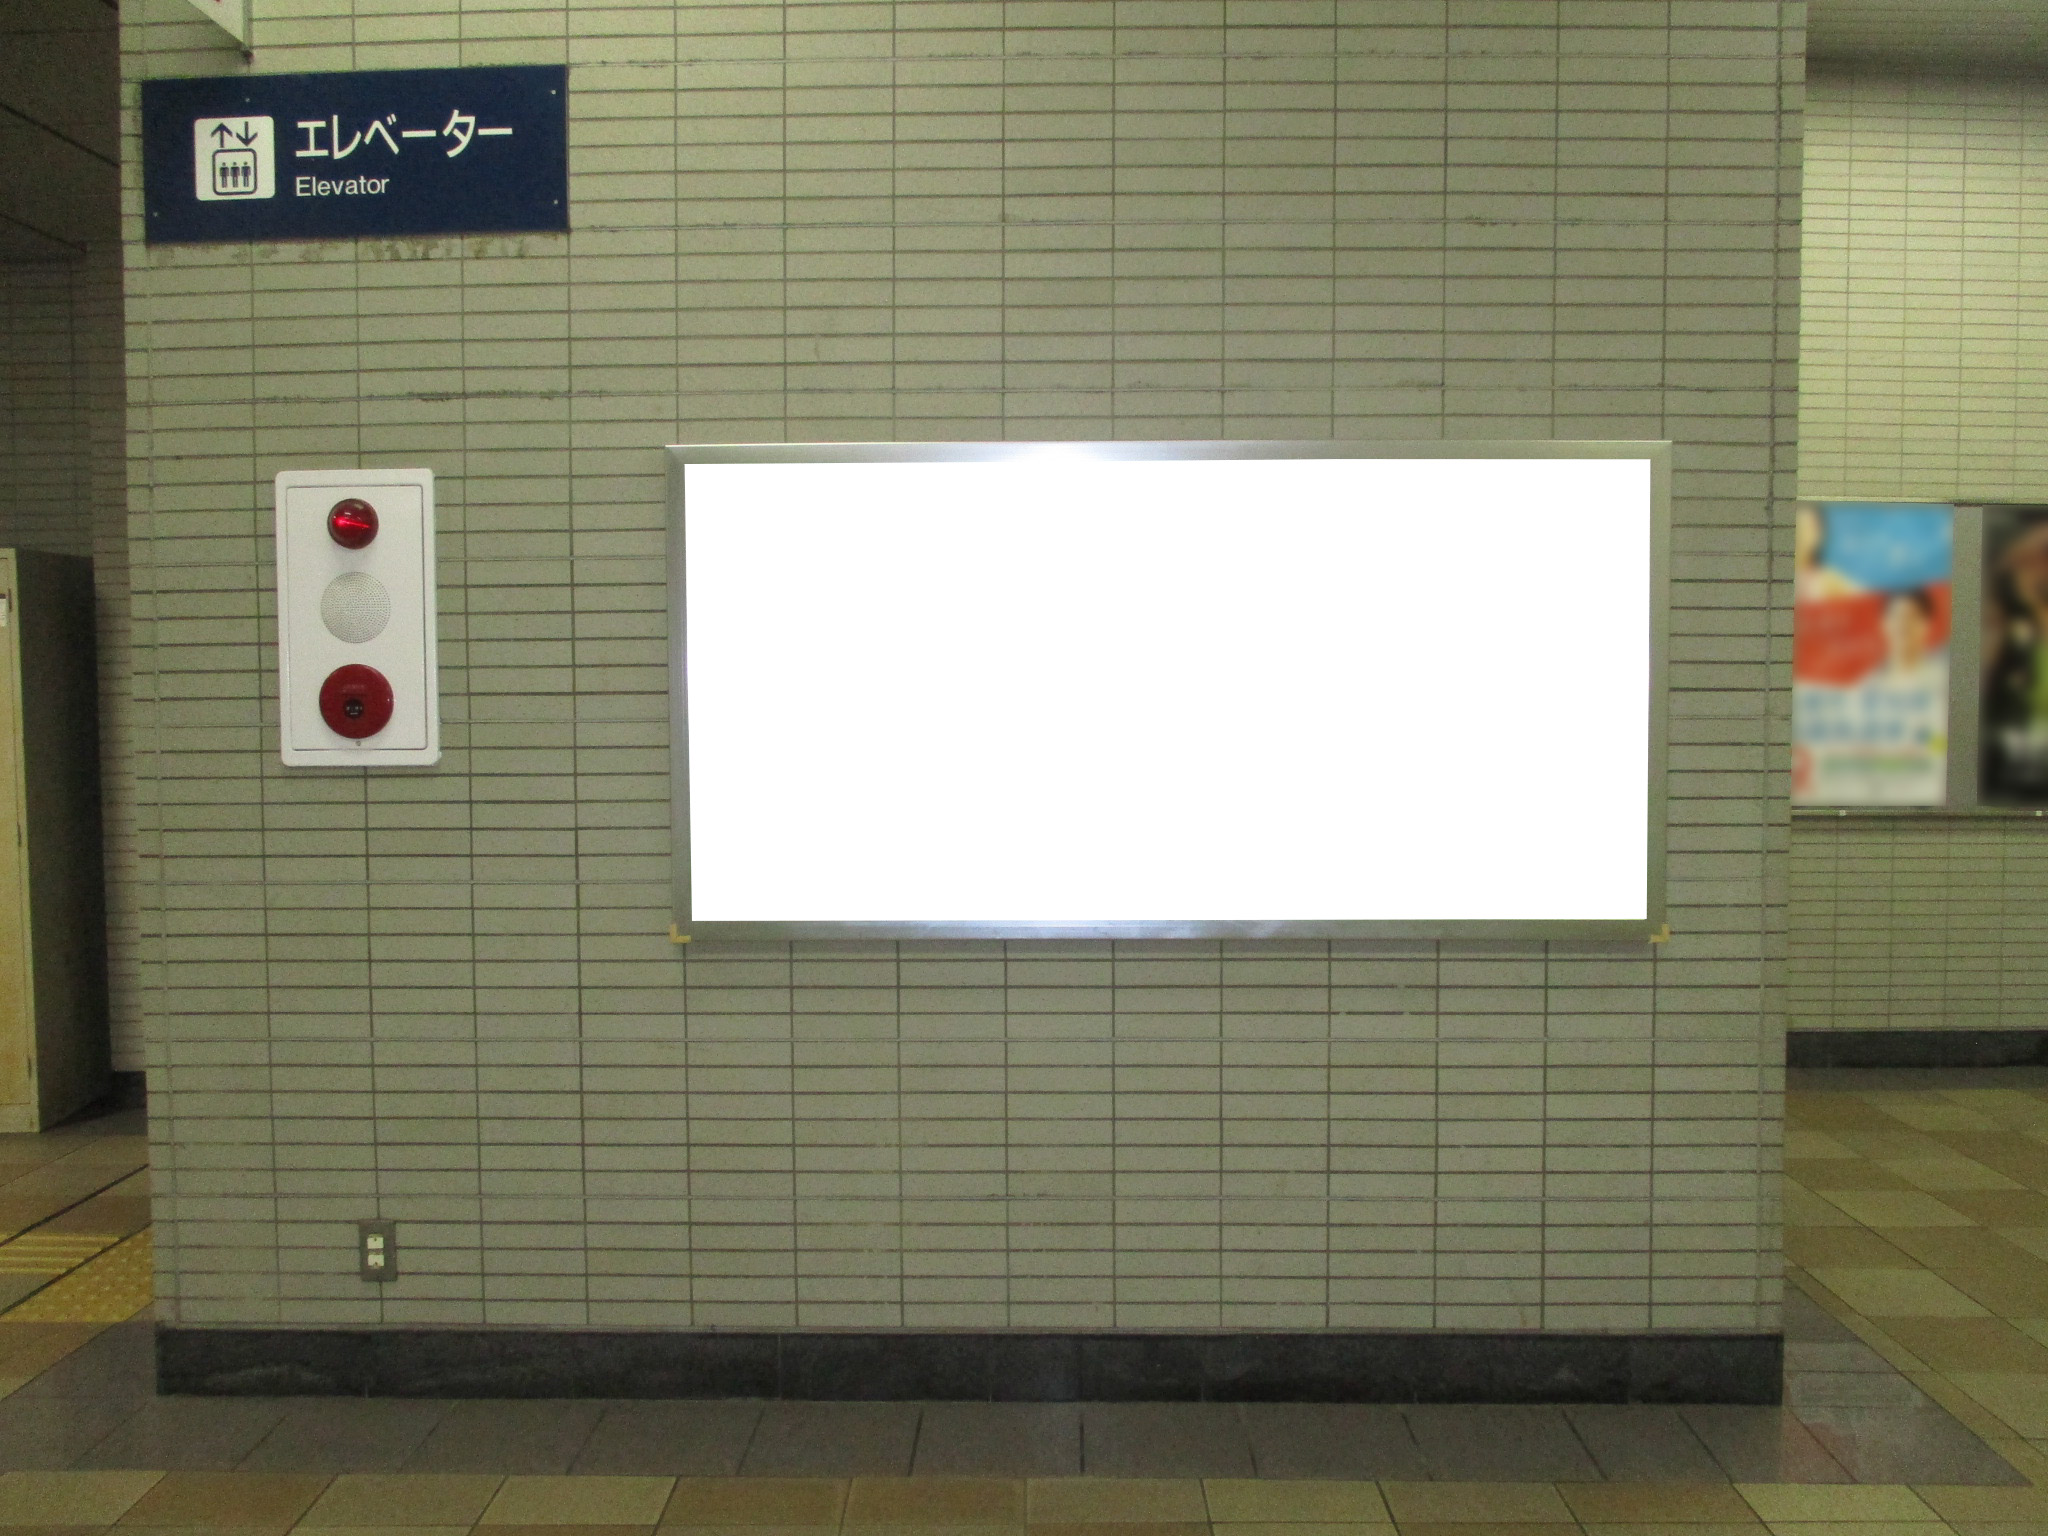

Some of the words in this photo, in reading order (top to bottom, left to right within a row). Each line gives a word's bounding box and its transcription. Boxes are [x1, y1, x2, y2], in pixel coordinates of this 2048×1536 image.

[296, 109, 513, 159] エレベーター
[296, 175, 390, 197] Elevator
